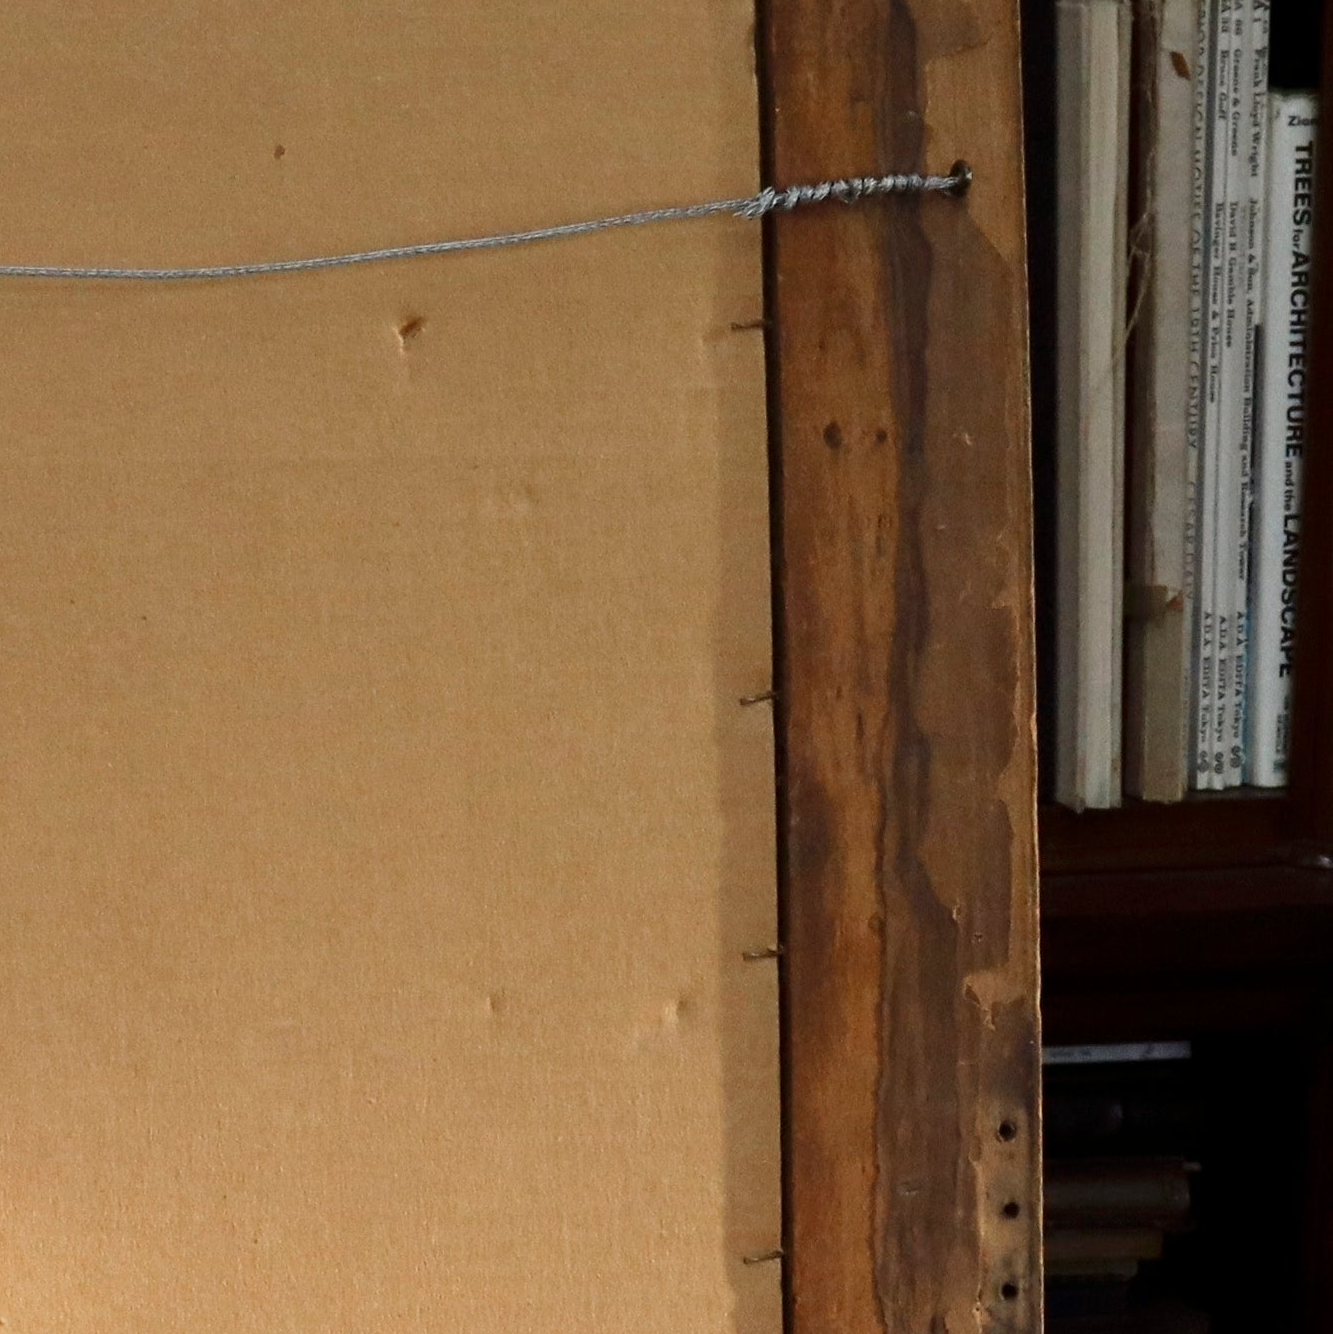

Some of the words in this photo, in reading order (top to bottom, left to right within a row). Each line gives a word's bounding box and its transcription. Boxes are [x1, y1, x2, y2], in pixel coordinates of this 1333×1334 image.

[1249, 92, 1262, 128] Lloyd
[1248, 132, 1261, 178] Wright
[1291, 140, 1314, 227] TREES
[1290, 227, 1305, 250] for
[1282, 250, 1313, 459] ARCHITECTURE
[1239, 396, 1252, 452] Building
[1240, 454, 1250, 477] and
[1283, 460, 1297, 488] and
[1282, 489, 1296, 512] the
[1237, 542, 1247, 582] Tower
[1278, 513, 1303, 679] LANDSCAPE
[1217, 658, 1227, 701] EDITA
[1234, 655, 1244, 698] EDITA
[1199, 704, 1210, 743] Tokyo
[1215, 704, 1226, 743] Tokyo
[1231, 702, 1243, 739] Tokyo
